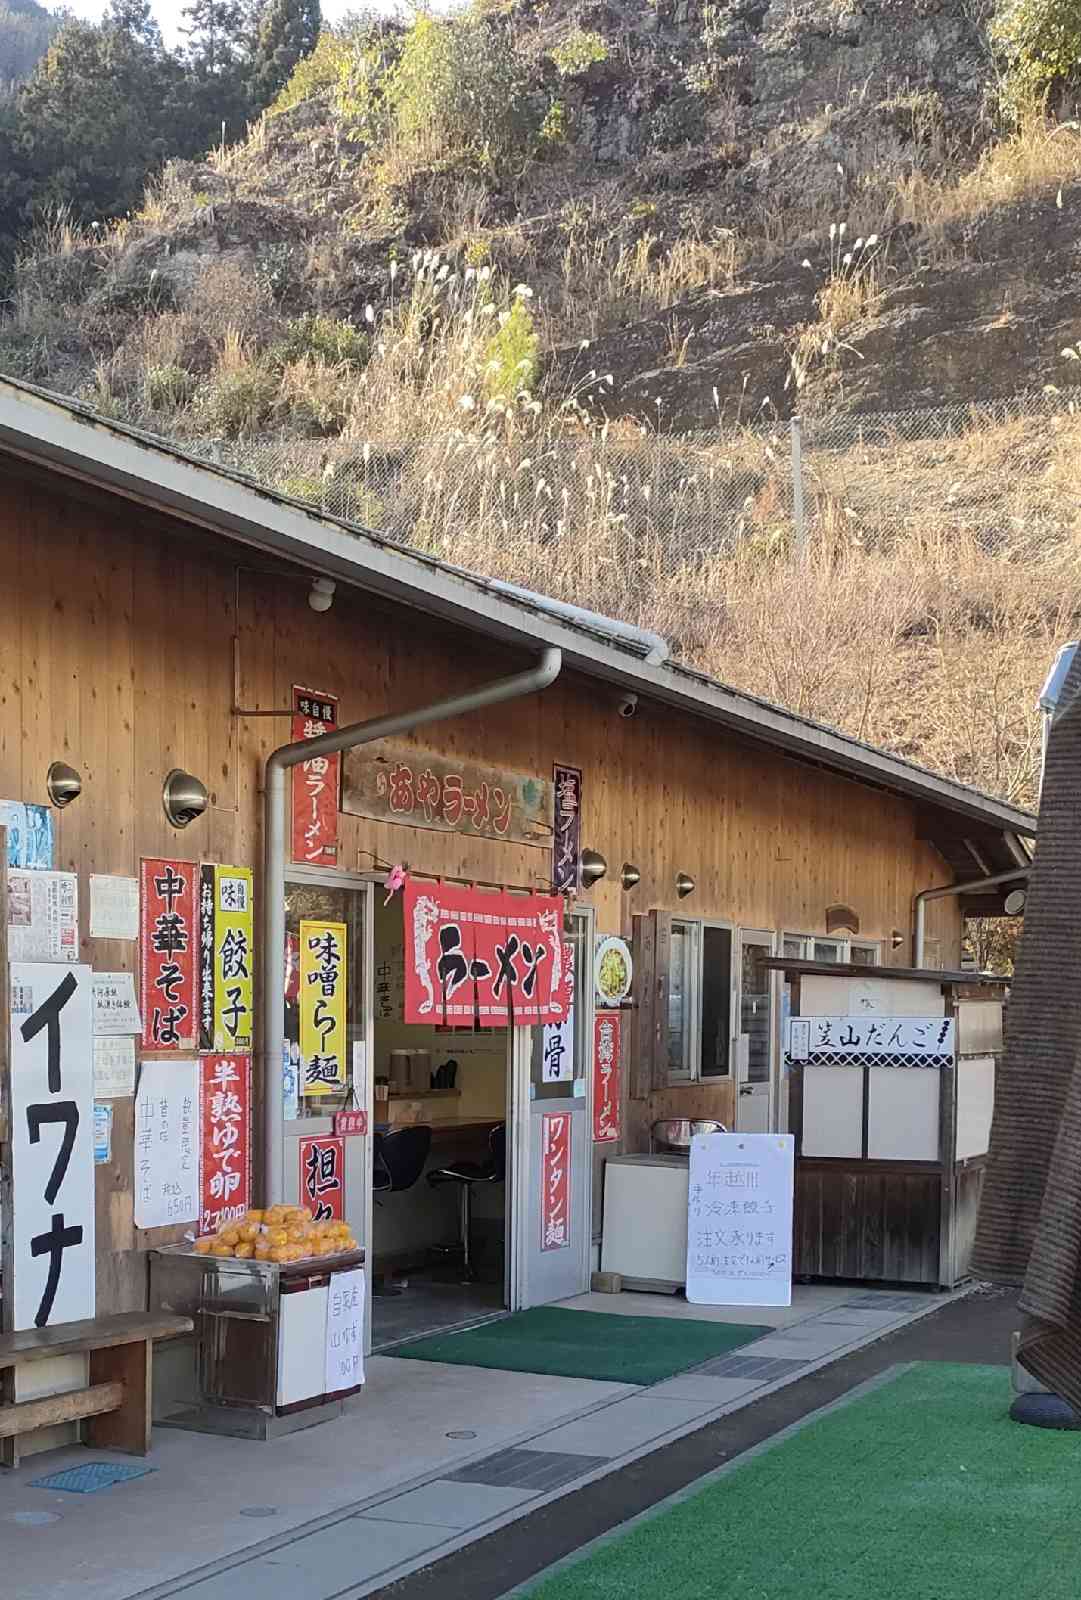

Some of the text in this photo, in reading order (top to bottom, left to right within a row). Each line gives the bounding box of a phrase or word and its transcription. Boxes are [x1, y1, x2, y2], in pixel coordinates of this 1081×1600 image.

[300, 701, 332, 721] 味自慢
[152, 866, 188, 1043] 中華そば
[219, 929, 249, 1037] 餃子
[305, 931, 341, 1085] 味噌らー麺
[436, 923, 548, 1000] ラーメン
[20, 971, 83, 1328] イワナ
[209, 1060, 242, 1201] 半熟ゆで卵
